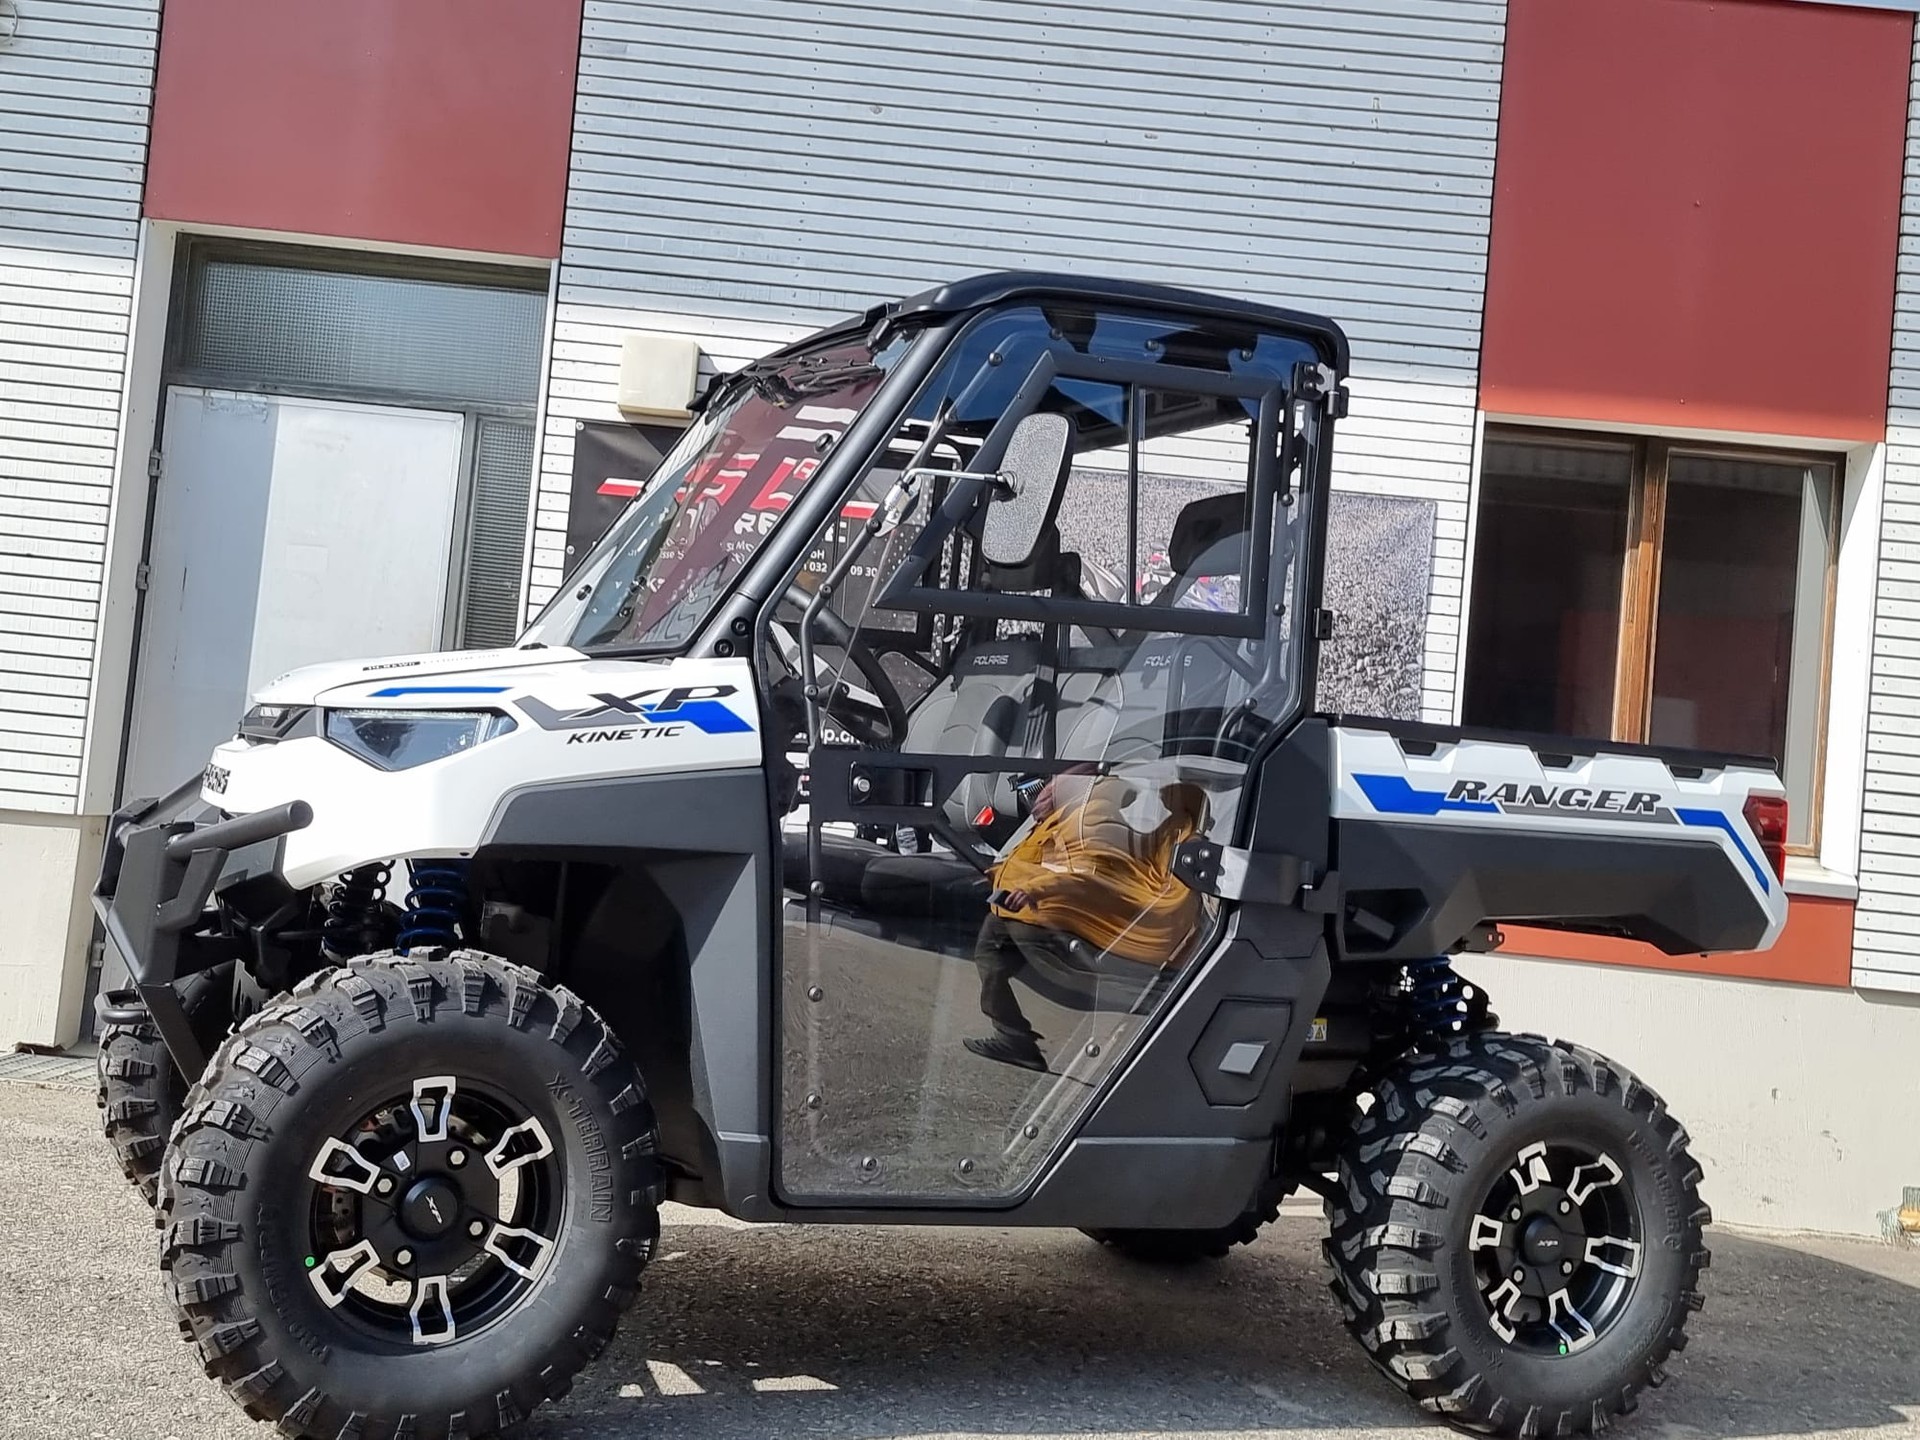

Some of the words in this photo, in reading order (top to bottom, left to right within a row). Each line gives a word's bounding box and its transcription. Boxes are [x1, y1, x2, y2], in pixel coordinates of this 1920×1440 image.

[809, 562, 828, 574] 032
[850, 565, 863, 577] 09
[559, 684, 739, 722] XP
[566, 725, 687, 746] KINETIC
[1446, 778, 1664, 815] RANGER
